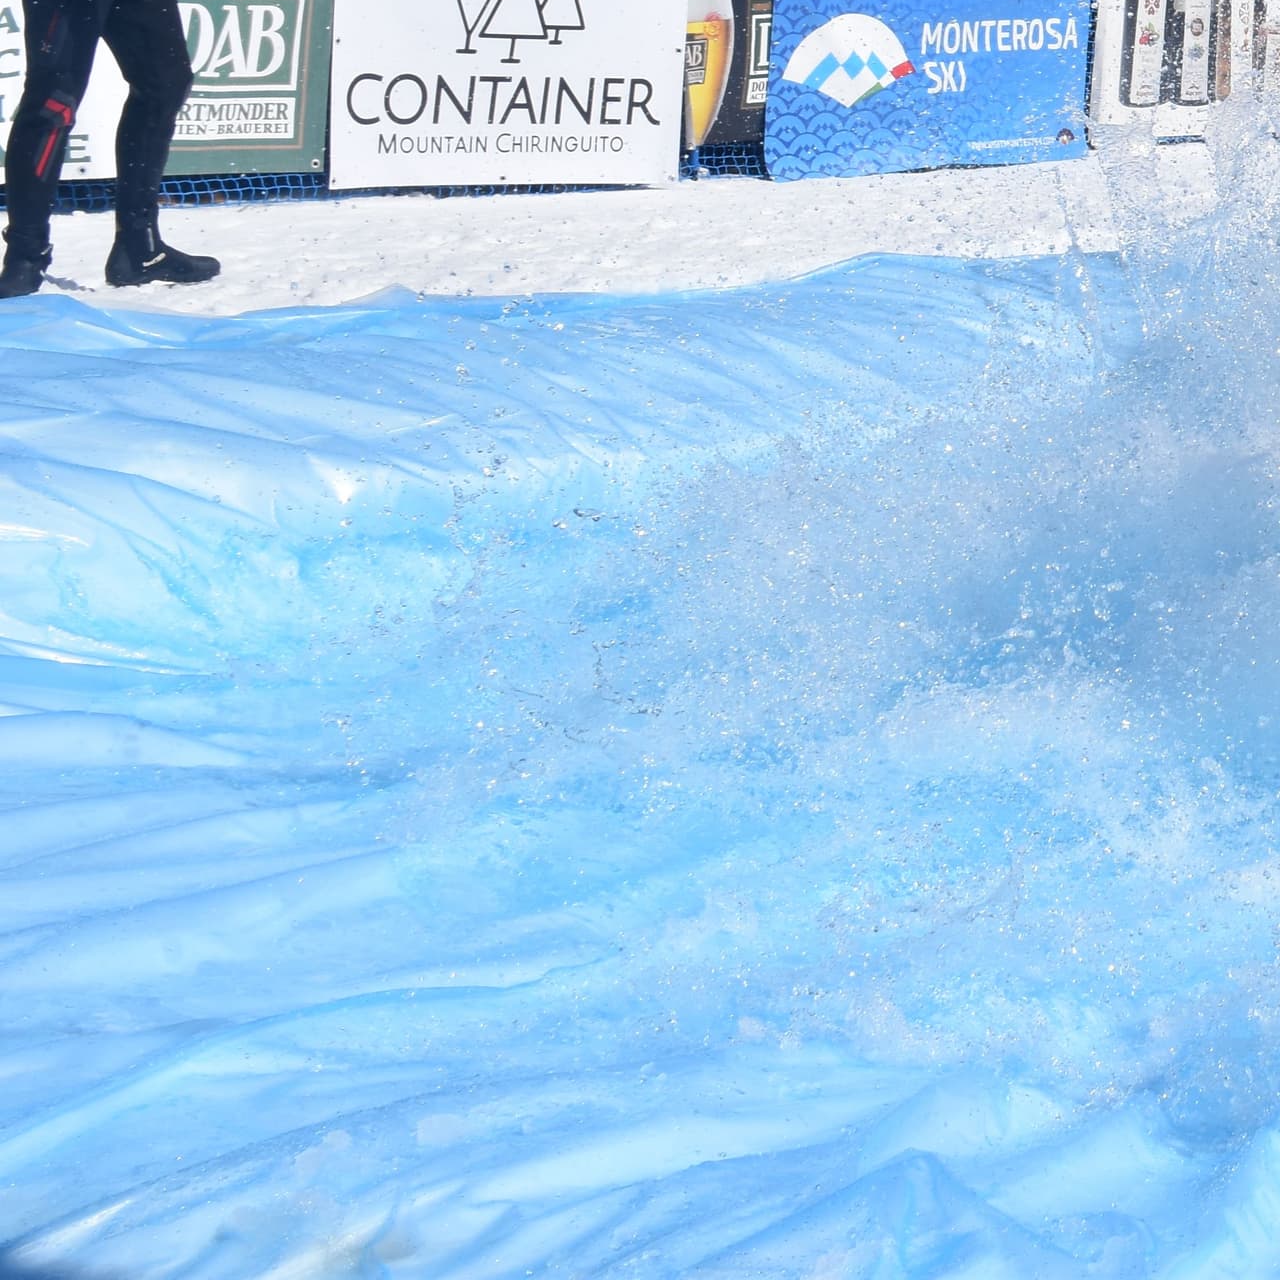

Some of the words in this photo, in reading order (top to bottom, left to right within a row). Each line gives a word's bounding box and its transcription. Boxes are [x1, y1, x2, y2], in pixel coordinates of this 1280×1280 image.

[176, 3, 286, 78] DAB
[920, 17, 1078, 55] MONTEROSA
[686, 44, 703, 67] AB
[924, 61, 967, 94] SKI
[178, 103, 288, 122] RTMUNDER
[346, 73, 661, 126] CONTAINER
[175, 123, 288, 135] IEN-BRAUEREI
[378, 134, 488, 155] MOUNTAIN
